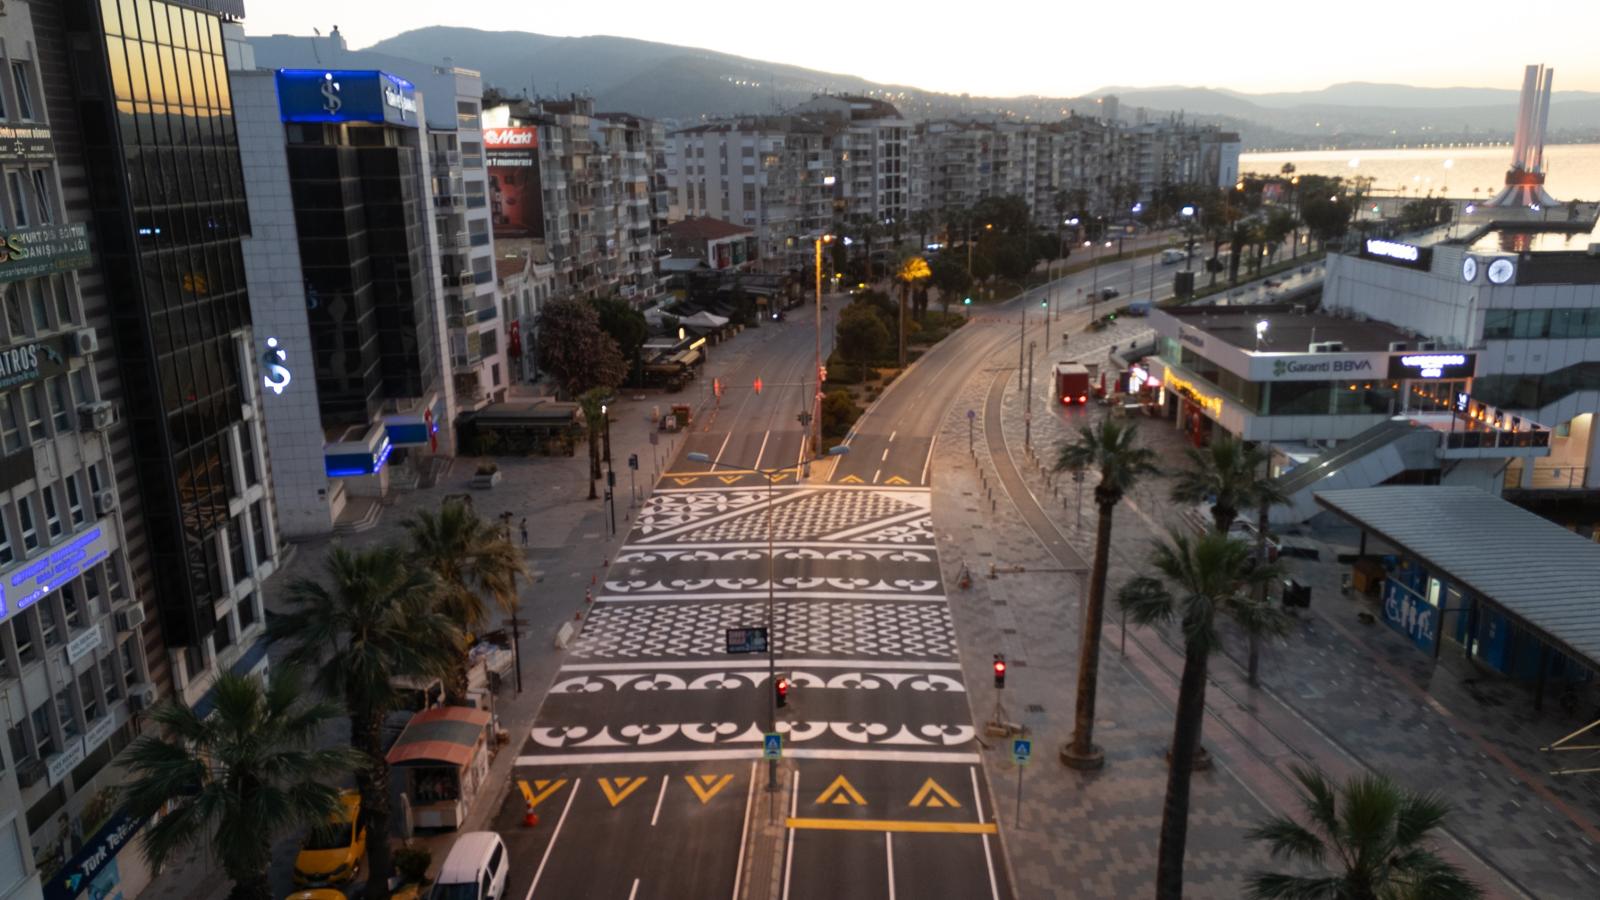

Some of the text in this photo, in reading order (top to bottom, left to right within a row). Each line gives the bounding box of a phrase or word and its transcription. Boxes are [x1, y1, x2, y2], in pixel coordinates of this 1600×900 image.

[1287, 360, 1372, 373] Garanti BBVA
[81, 846, 107, 876] Türk
